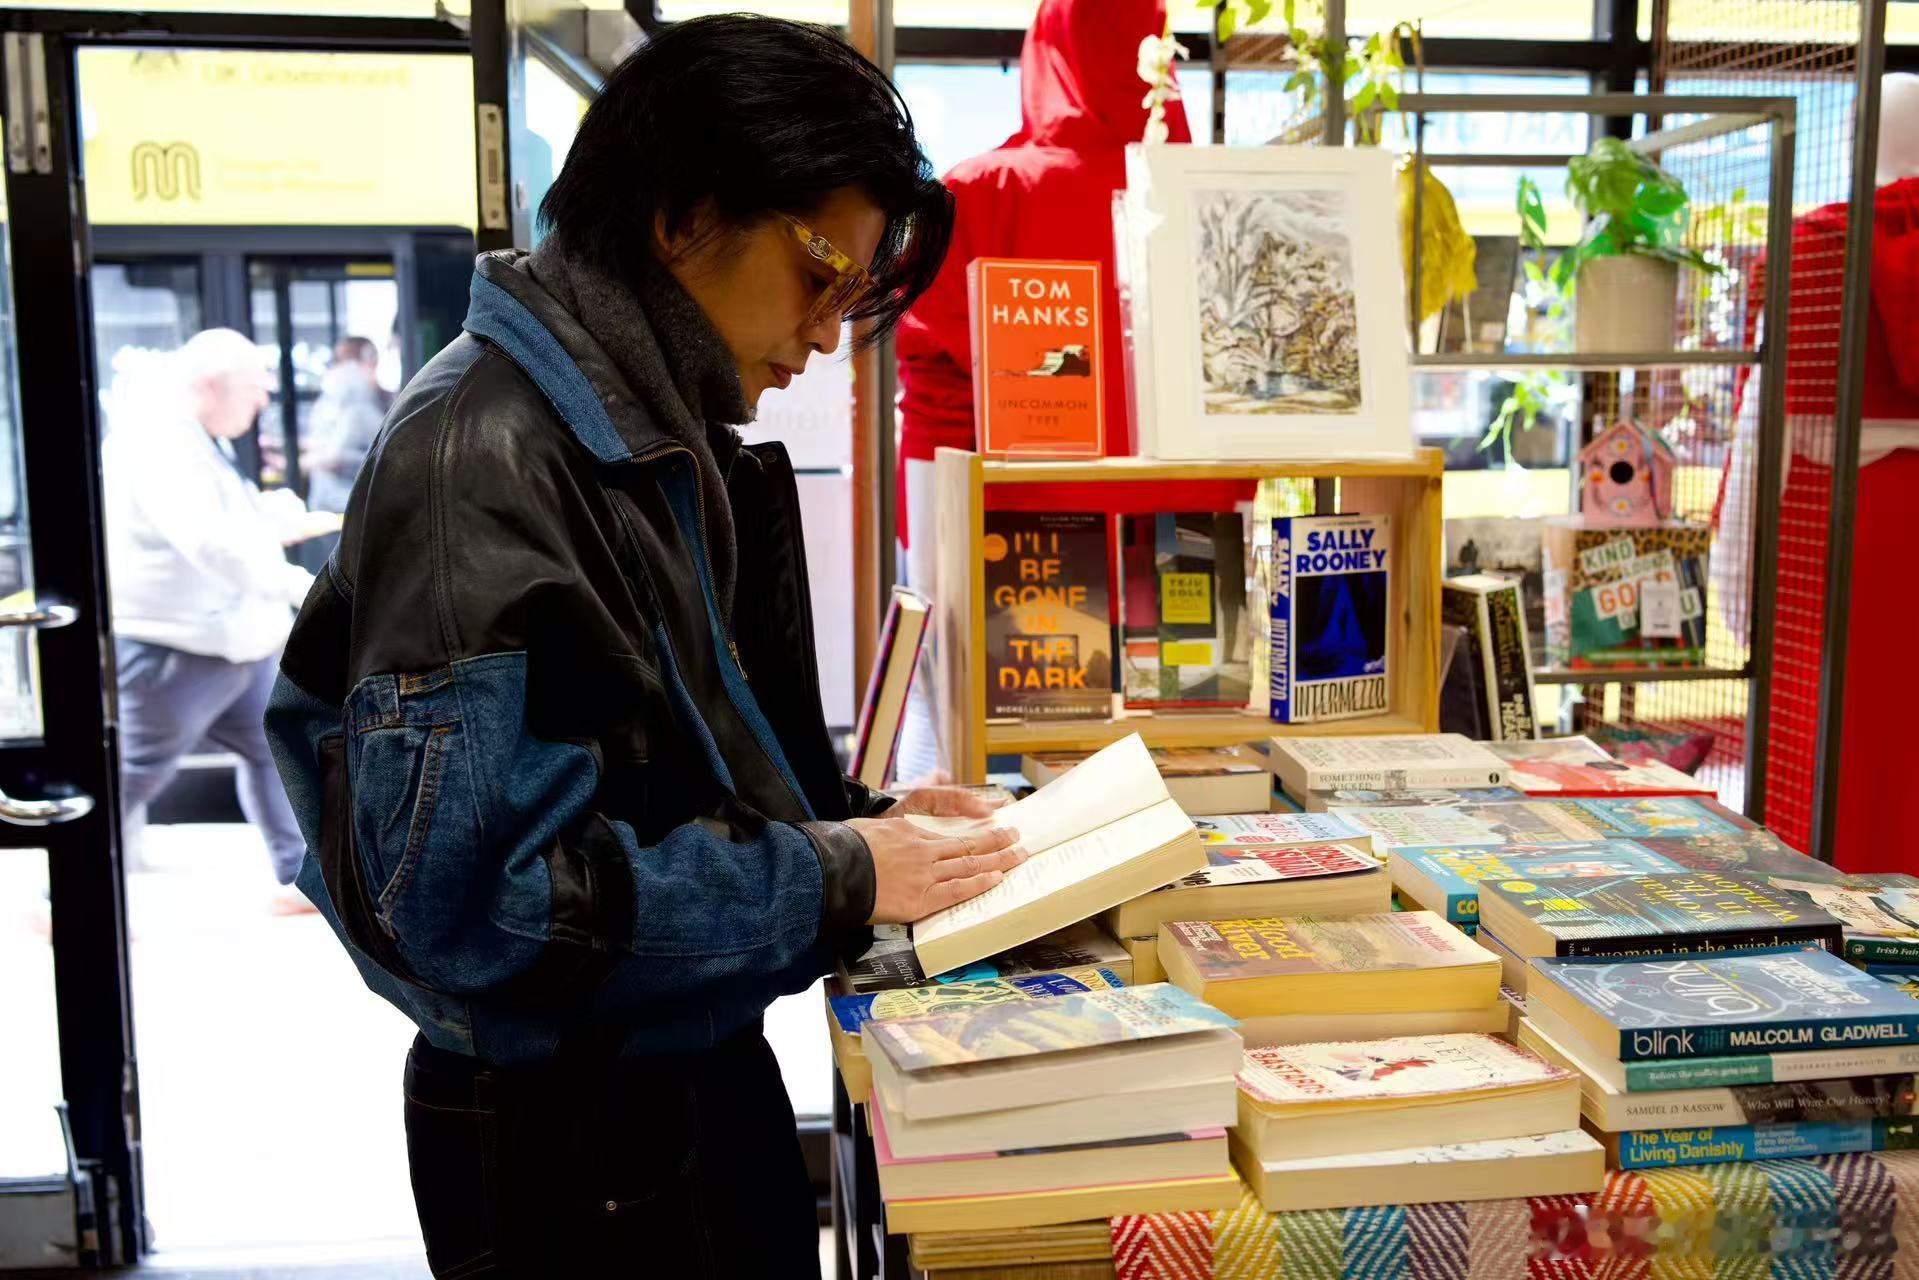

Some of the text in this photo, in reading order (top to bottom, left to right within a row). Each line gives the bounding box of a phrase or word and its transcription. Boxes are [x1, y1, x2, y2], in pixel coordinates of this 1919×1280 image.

[1008, 278, 1071, 300] TOM
[992, 304, 1089, 327] HANKS
[998, 400, 1088, 411] UNCOMMON
[1307, 528, 1375, 552] SALLY
[1296, 549, 1386, 573] ROONEY
[1584, 540, 1634, 568] KIND
[1020, 558, 1061, 582] BE
[1277, 537, 1290, 599] SALLY
[993, 585, 1087, 609] GONE
[1025, 614, 1058, 633] IN
[1008, 639, 1074, 662] THE
[1271, 617, 1288, 700] INTERMEZZO
[998, 667, 1089, 690] DARK
[1294, 677, 1386, 718] INTERMEZZO
[1500, 701, 1515, 740] HEAR
[1319, 772, 1382, 784] SOMETHING
[1330, 781, 1374, 792] WICKED
[1209, 919, 1272, 960] River
[1247, 918, 1320, 960] Blood
[1876, 947, 1899, 955] Irish
[1642, 961, 1760, 1017] blink
[1633, 1023, 1909, 1056] blink MALCOLM GLADWELL
[1626, 1105, 1667, 1117] SAMUEL
[1682, 1103, 1725, 1115] KASSOW
[1747, 1100, 1771, 1110] Who
[1775, 1098, 1795, 1110] Will
[1798, 1097, 1825, 1109] Write
[1827, 1096, 1845, 1106] Our
[1631, 1127, 1714, 1146] The Year of
[1630, 1141, 1745, 1163] Living Danishly
